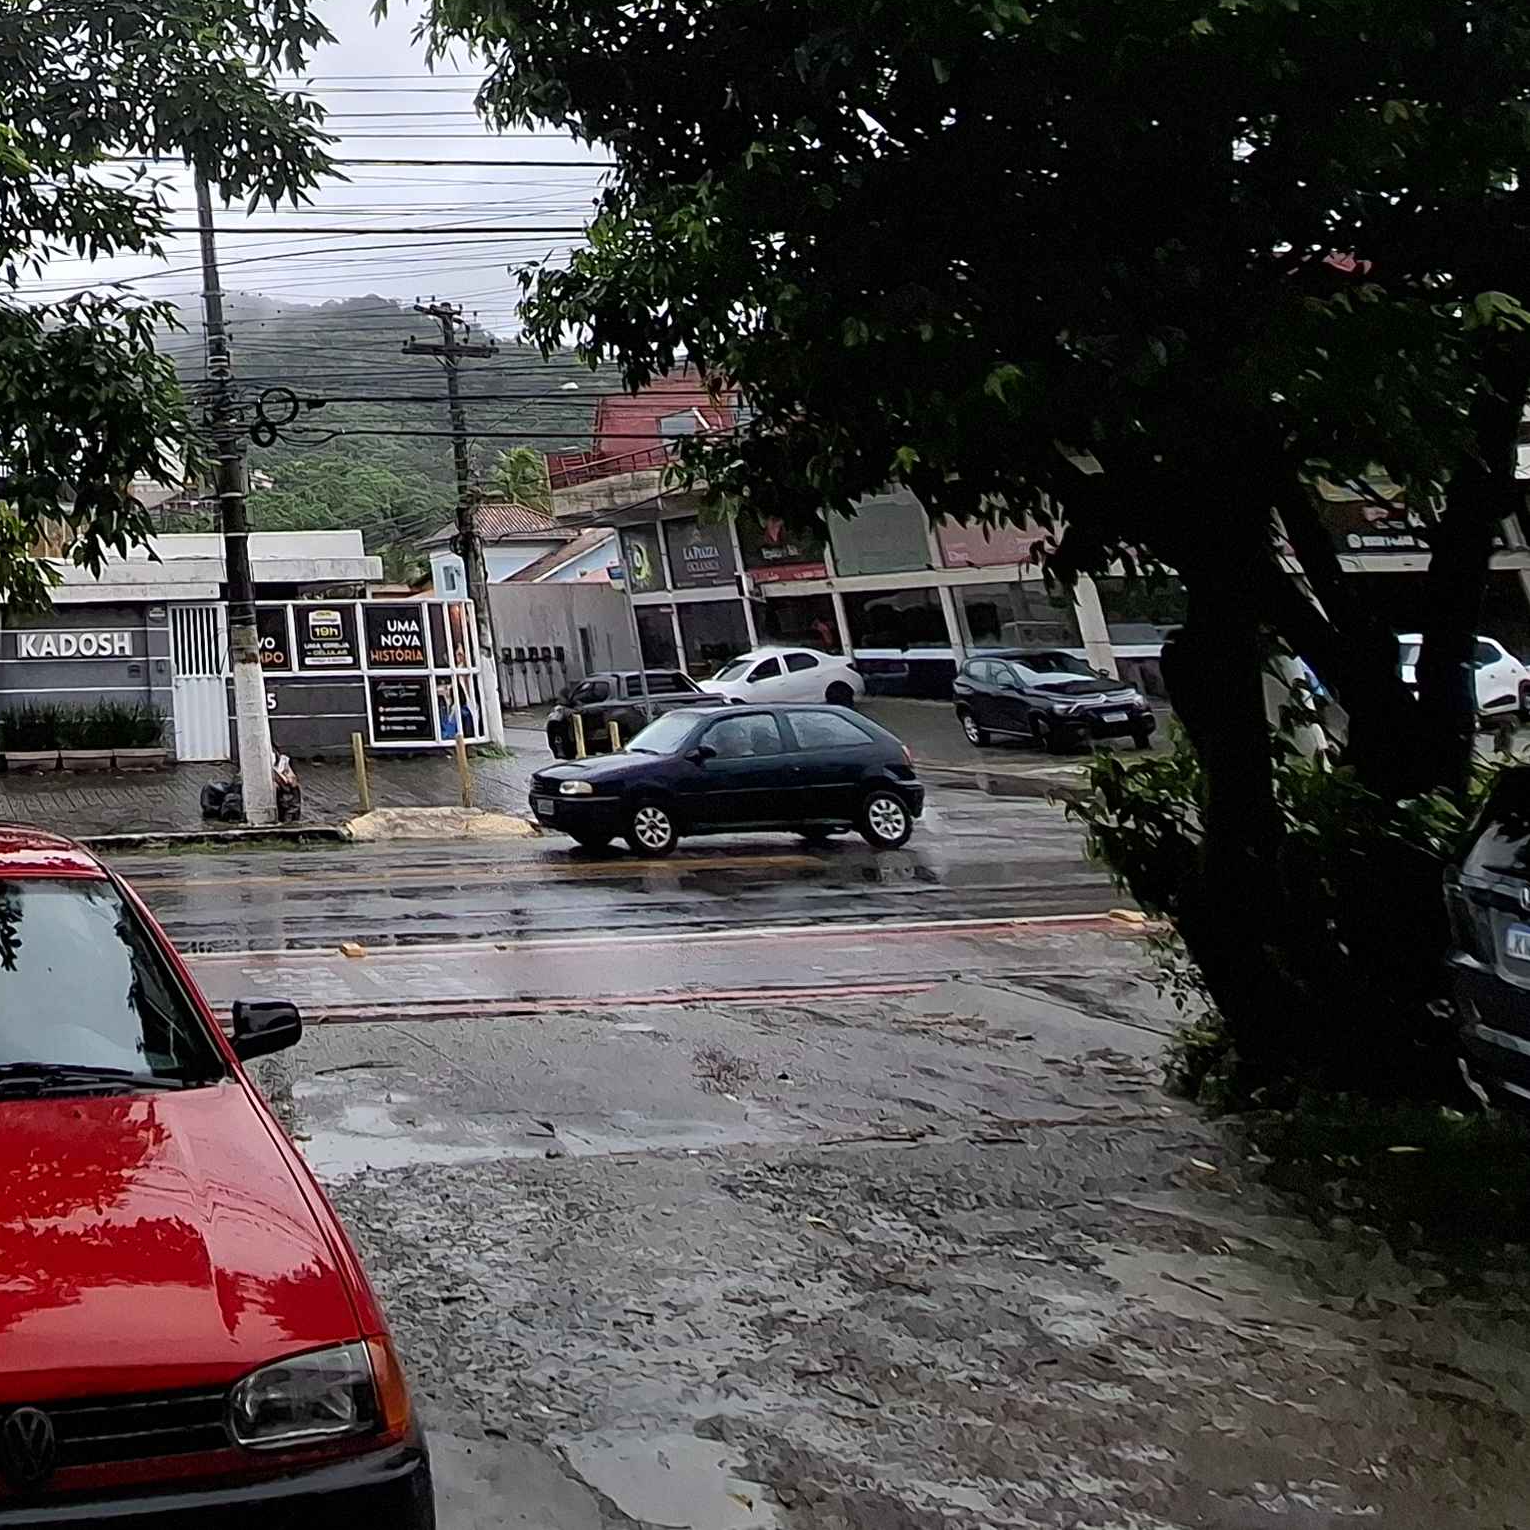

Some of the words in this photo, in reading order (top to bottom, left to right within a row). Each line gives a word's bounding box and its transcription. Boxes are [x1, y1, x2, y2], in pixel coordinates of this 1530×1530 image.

[314, 627, 338, 636] 19h
[387, 620, 420, 632] UMA
[19, 633, 132, 658] KADOSH
[257, 636, 276, 649] VO
[381, 634, 421, 647] NOVA
[371, 647, 423, 662] HISTÓRIA
[266, 692, 278, 710] 5
